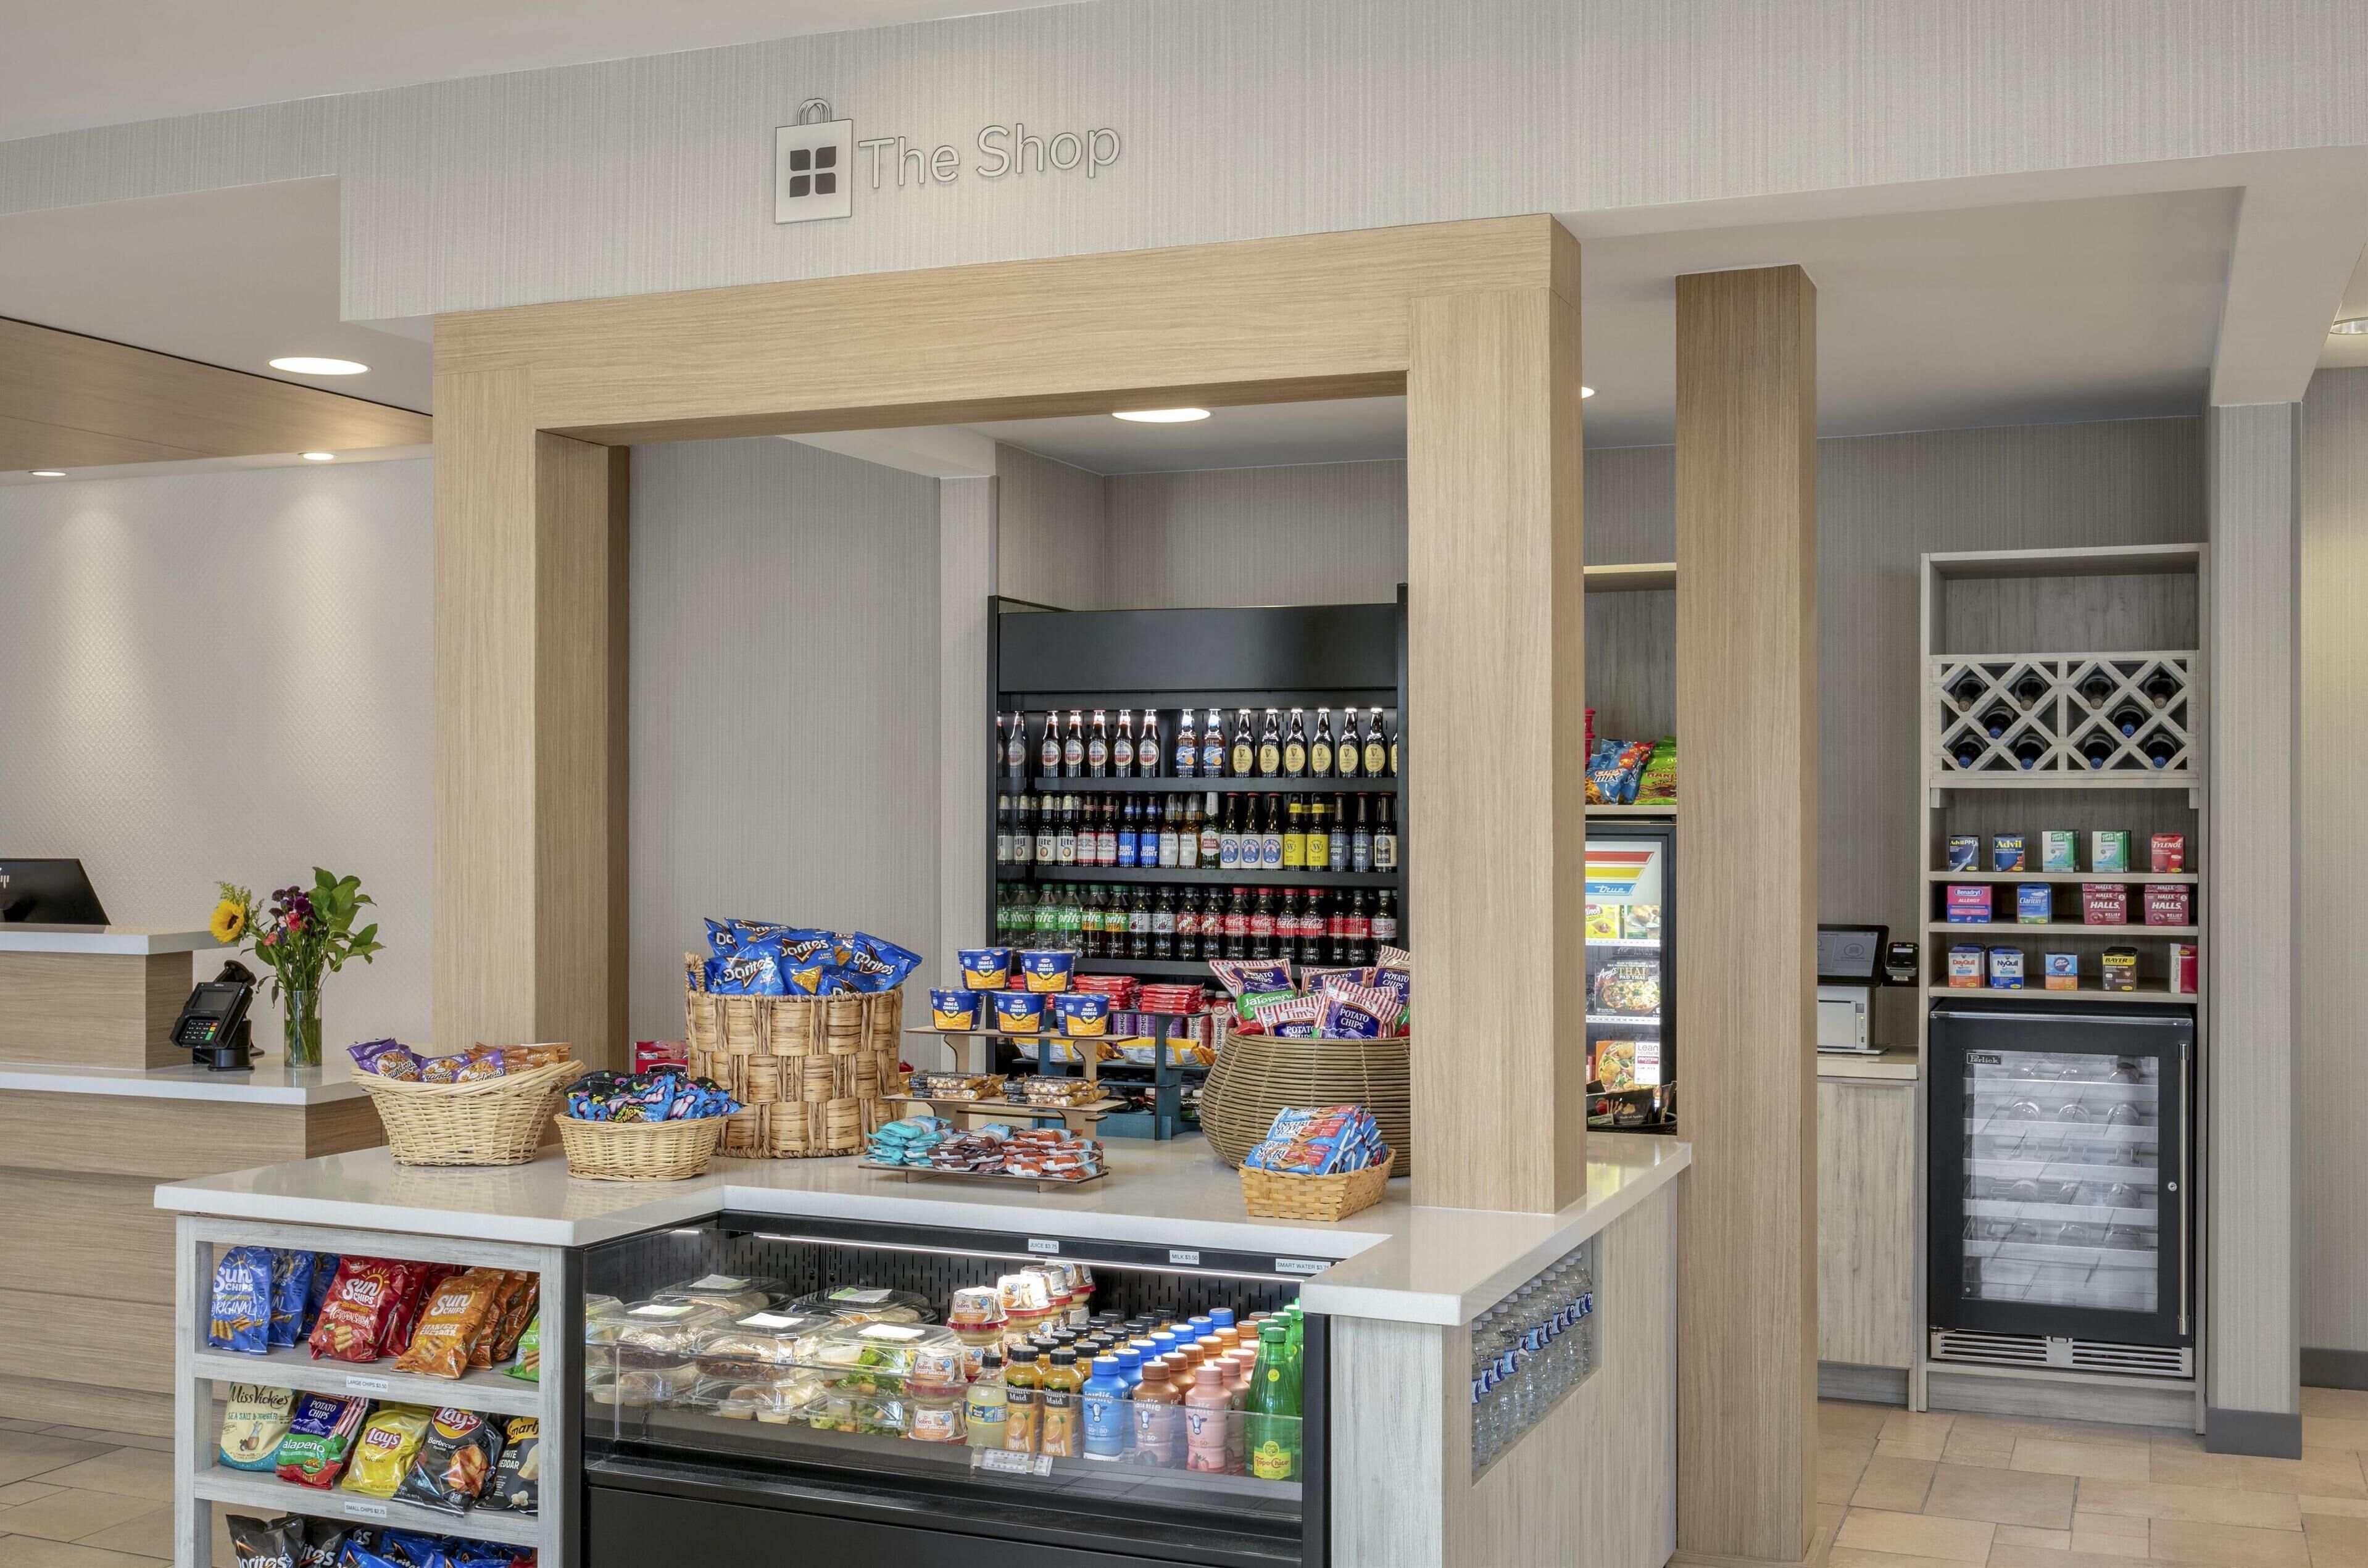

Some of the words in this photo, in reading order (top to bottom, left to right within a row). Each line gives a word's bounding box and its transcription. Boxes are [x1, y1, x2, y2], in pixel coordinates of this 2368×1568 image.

[858, 135, 960, 189] The
[976, 122, 1121, 179] Shop
[1038, 837, 1051, 846] Lite
[1060, 837, 1074, 846] Lite
[1996, 840, 2022, 848] Advil
[1594, 885, 1626, 894] true
[1034, 911, 1054, 923] prite
[1300, 917, 1323, 929] Coca-Cola
[781, 939, 829, 957] Doritos
[723, 956, 774, 982] Doritos
[854, 951, 896, 975] Doritos
[1952, 959, 1975, 967] DayQuil
[1383, 972, 1410, 983] POTATO
[1597, 967, 1618, 982] Amy's
[1618, 968, 1647, 976] THAI
[1382, 979, 1405, 990] CHIPS
[1284, 1010, 1315, 1019] Tim's
[1340, 1008, 1369, 1023] POTATO
[1340, 1018, 1365, 1030] CHIPS
[214, 1267, 254, 1292] Sun
[225, 1284, 254, 1292] CHIPS
[342, 1278, 378, 1300] Sun
[353, 1293, 375, 1304] CHIPS
[430, 1295, 470, 1316] Sun
[442, 1306, 467, 1315] CHIPS
[229, 1385, 254, 1403] Miss
[254, 1385, 290, 1409] Vickie's
[1009, 1393, 1027, 1401] Maid
[1046, 1396, 1063, 1405] Maid
[310, 1400, 336, 1412] POTATO
[228, 1412, 238, 1420] SEA
[239, 1412, 251, 1420] SALT
[309, 1409, 330, 1420] CHIPS
[436, 1406, 480, 1430] Lay's
[366, 1428, 401, 1449] Lay's
[428, 1437, 457, 1450] Barbecue
[283, 1438, 325, 1453] alapeño
[1255, 1456, 1270, 1467] Topo
[1271, 1458, 1289, 1469] Chico
